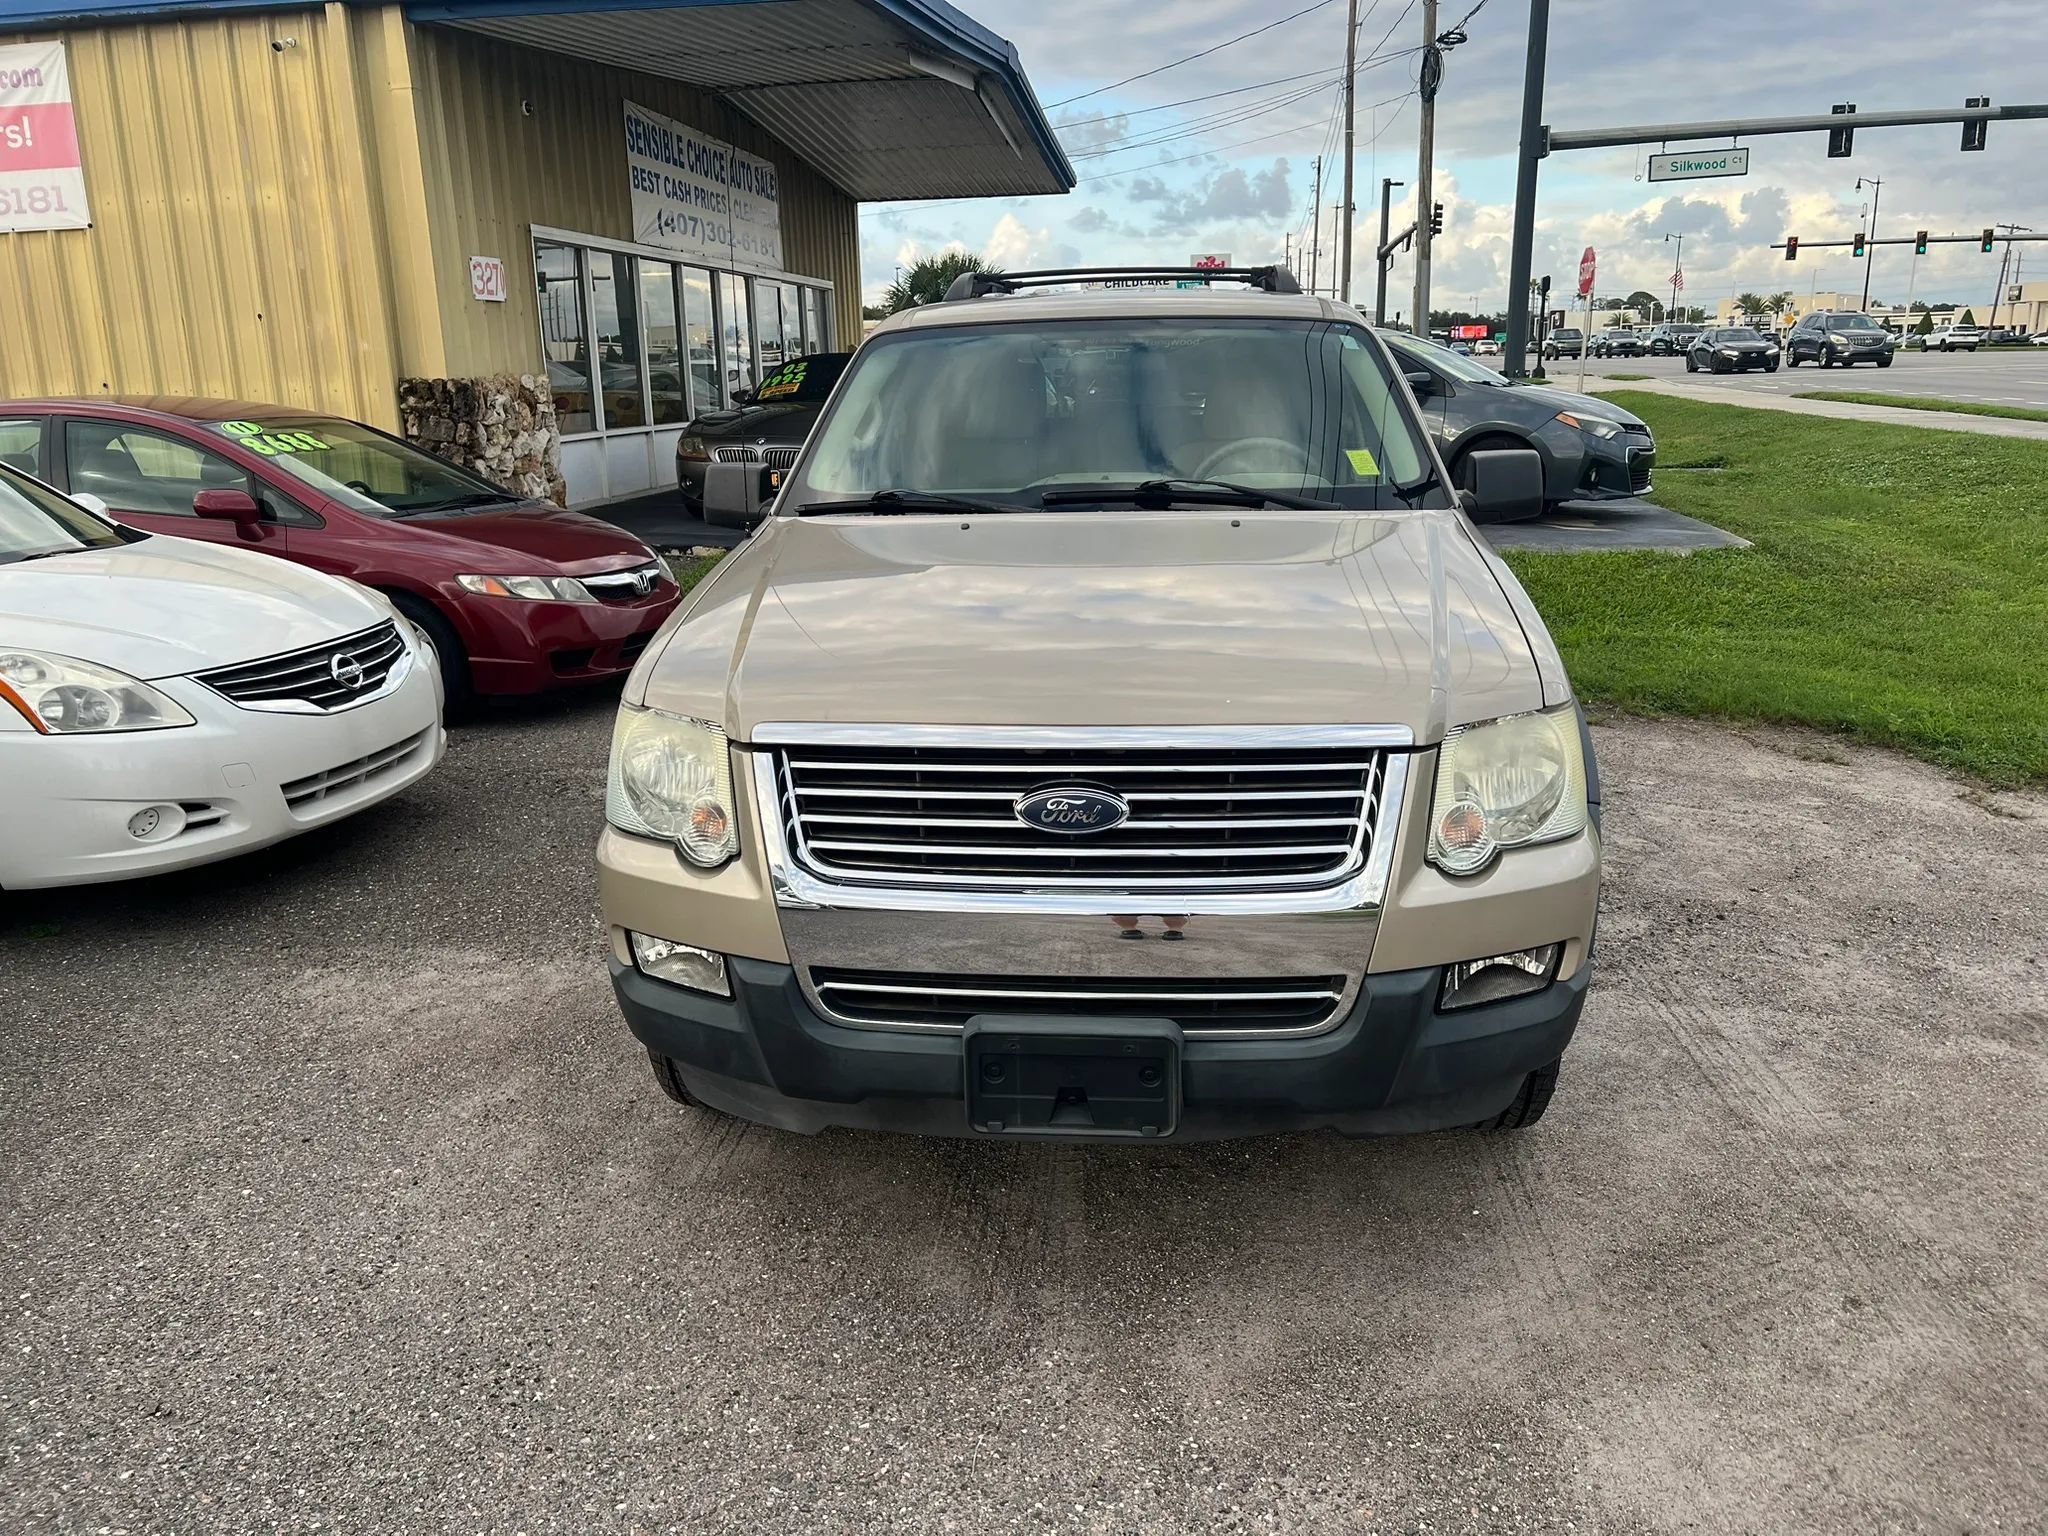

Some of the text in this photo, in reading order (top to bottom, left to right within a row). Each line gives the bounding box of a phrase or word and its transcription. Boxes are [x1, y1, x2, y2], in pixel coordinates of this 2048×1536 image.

[0, 115, 33, 149] s!
[626, 114, 685, 170] SENSIBLE
[686, 138, 726, 185] CHOICE
[729, 156, 753, 194] AUTO
[1670, 156, 1743, 173] Silkwood Ct
[631, 165, 661, 196] BEST
[664, 175, 691, 204] CASH
[694, 184, 728, 216] PRICES
[656, 208, 776, 259] (407)302-6181
[1040, 797, 1102, 824] Ford
